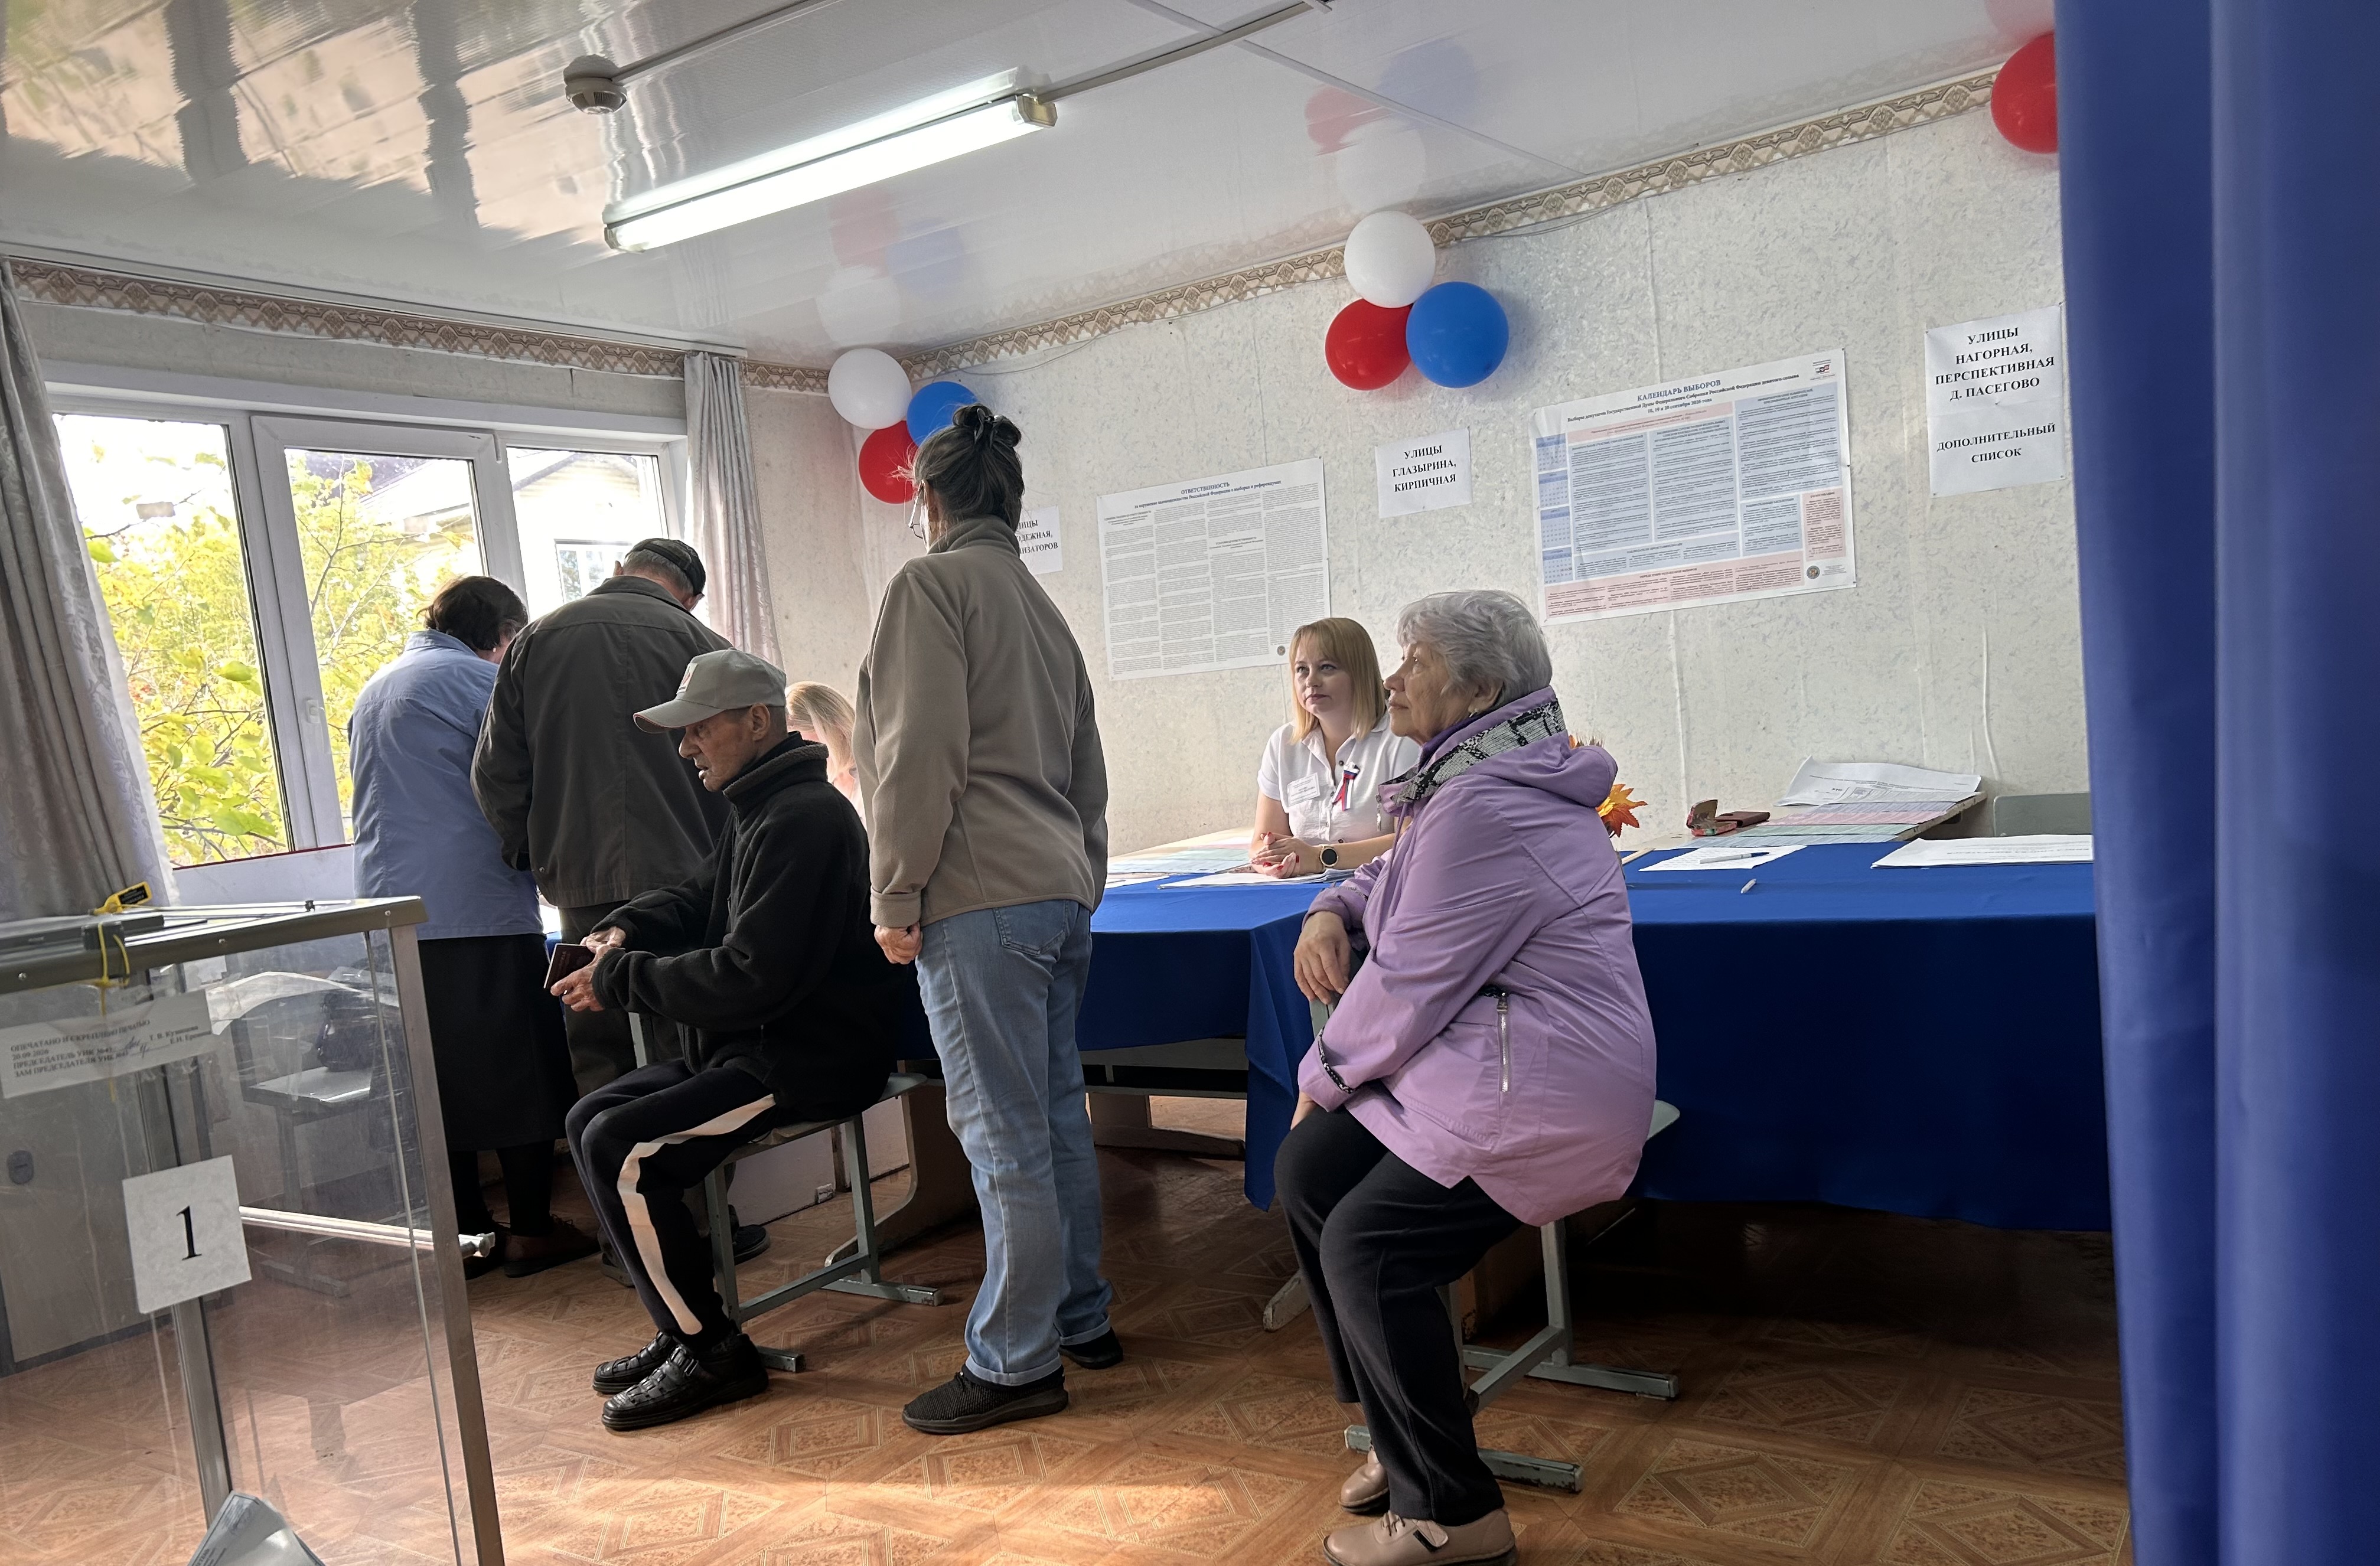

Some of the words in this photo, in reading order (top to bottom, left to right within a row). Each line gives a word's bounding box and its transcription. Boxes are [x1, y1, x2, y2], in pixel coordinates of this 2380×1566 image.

[1967, 327, 2019, 345] УЛИЦЫ
[1955, 343, 2033, 365] НАГОРНАЯ,
[1935, 356, 2055, 385] ПЕРСПЕКТИВНАЯ
[1637, 388, 1683, 402] КАЛЕНДАРЬ
[1683, 380, 1721, 393] ВЫБОРОВ
[1949, 390, 1962, 402] Д.
[1965, 377, 2040, 398] ПАСЕГОВО
[1936, 422, 2056, 452] ДОПОЛНИТЕЛЬНЫЙ
[1404, 445, 1442, 459] УЛИЦЫ
[1971, 448, 2022, 463] СПИСОК
[1392, 459, 1456, 477] ГЛАЗЫРИНА,
[1181, 482, 1230, 495] ОТВЕТСТВЕННОСТЬ
[1394, 474, 1456, 492] КИРПИЧНАЯ
[1016, 520, 1038, 530] ЛИЦЫ
[1016, 530, 1053, 543] ОДЕЖНАЯ,
[11, 1038, 61, 1052] ОПЕЧАТАНО
[14, 1052, 76, 1069] ПРЕДСЕДАТЕЛЬ
[34, 1055, 96, 1075] ПРЕДСЕДАТЕЛЯ
[176, 1205, 202, 1261] 1
